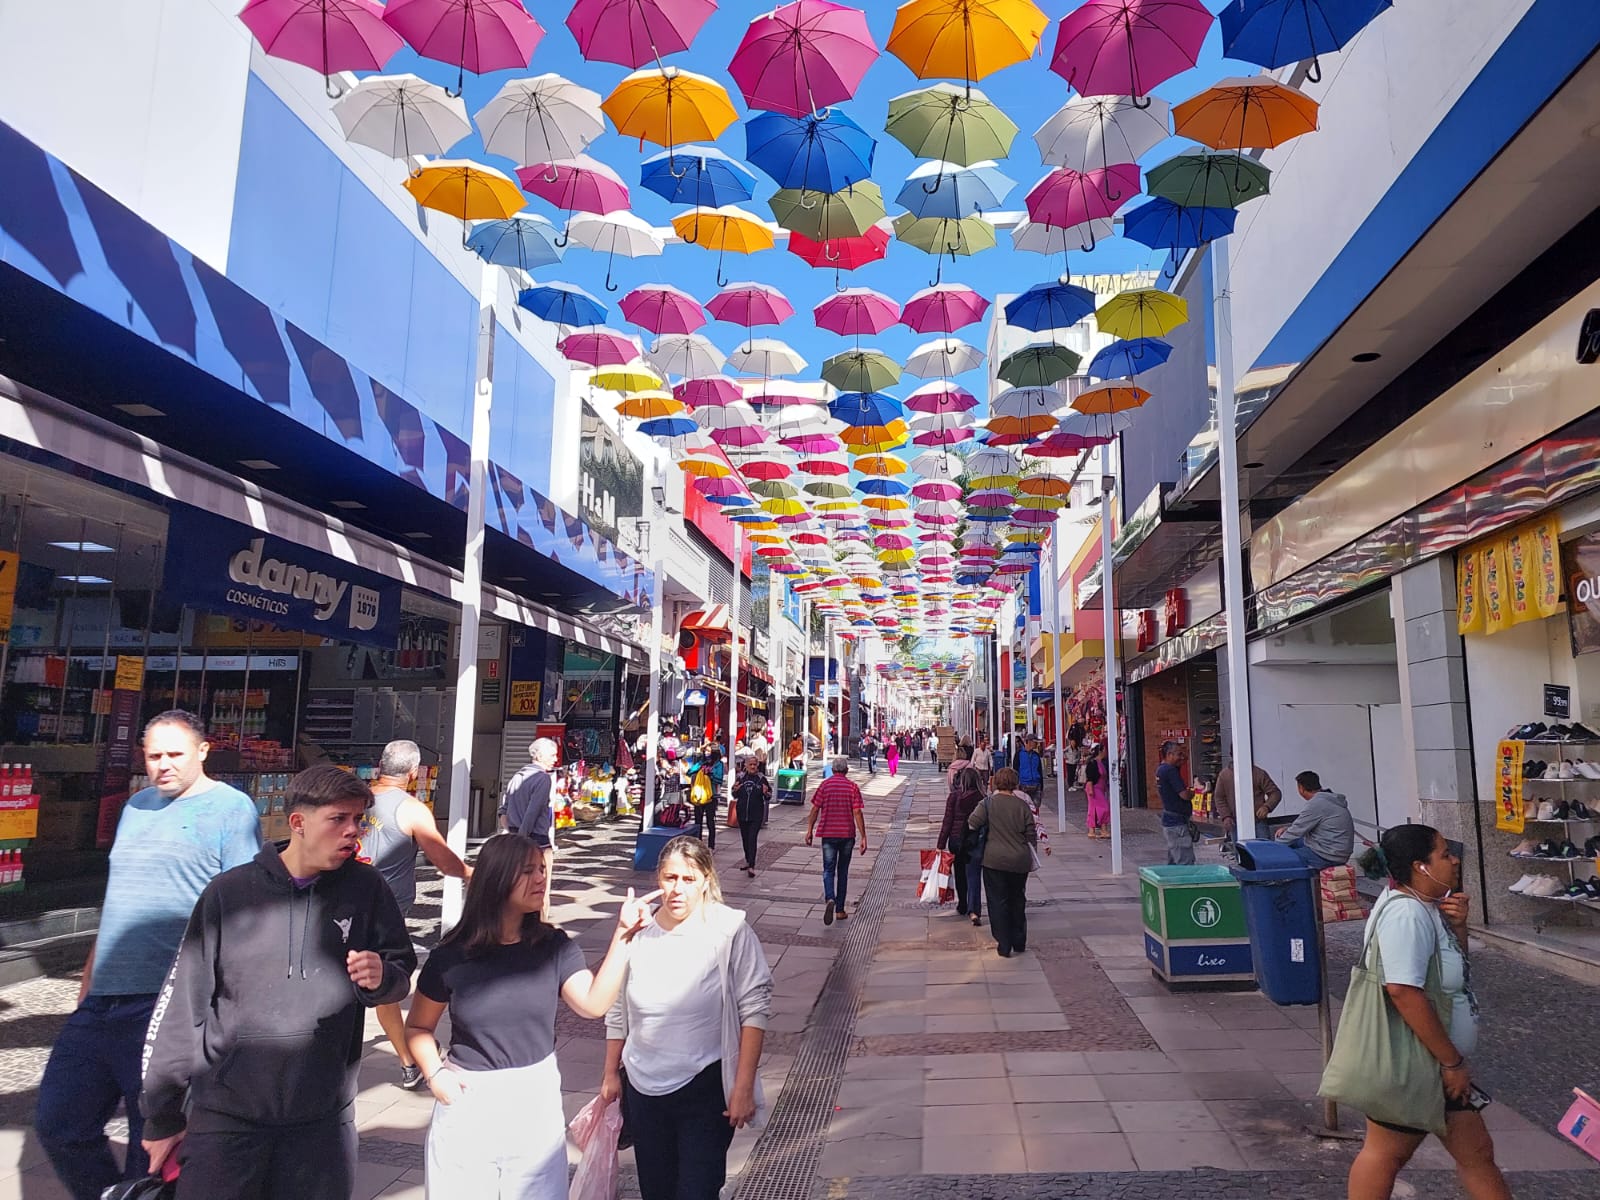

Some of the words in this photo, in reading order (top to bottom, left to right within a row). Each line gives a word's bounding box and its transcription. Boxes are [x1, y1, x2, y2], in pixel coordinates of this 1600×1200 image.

[582, 471, 616, 529] H&M
[229, 537, 349, 621] danny
[226, 588, 289, 615] COSMÉTICOS
[357, 600, 377, 618] 1978
[1197, 953, 1226, 967] lixo
